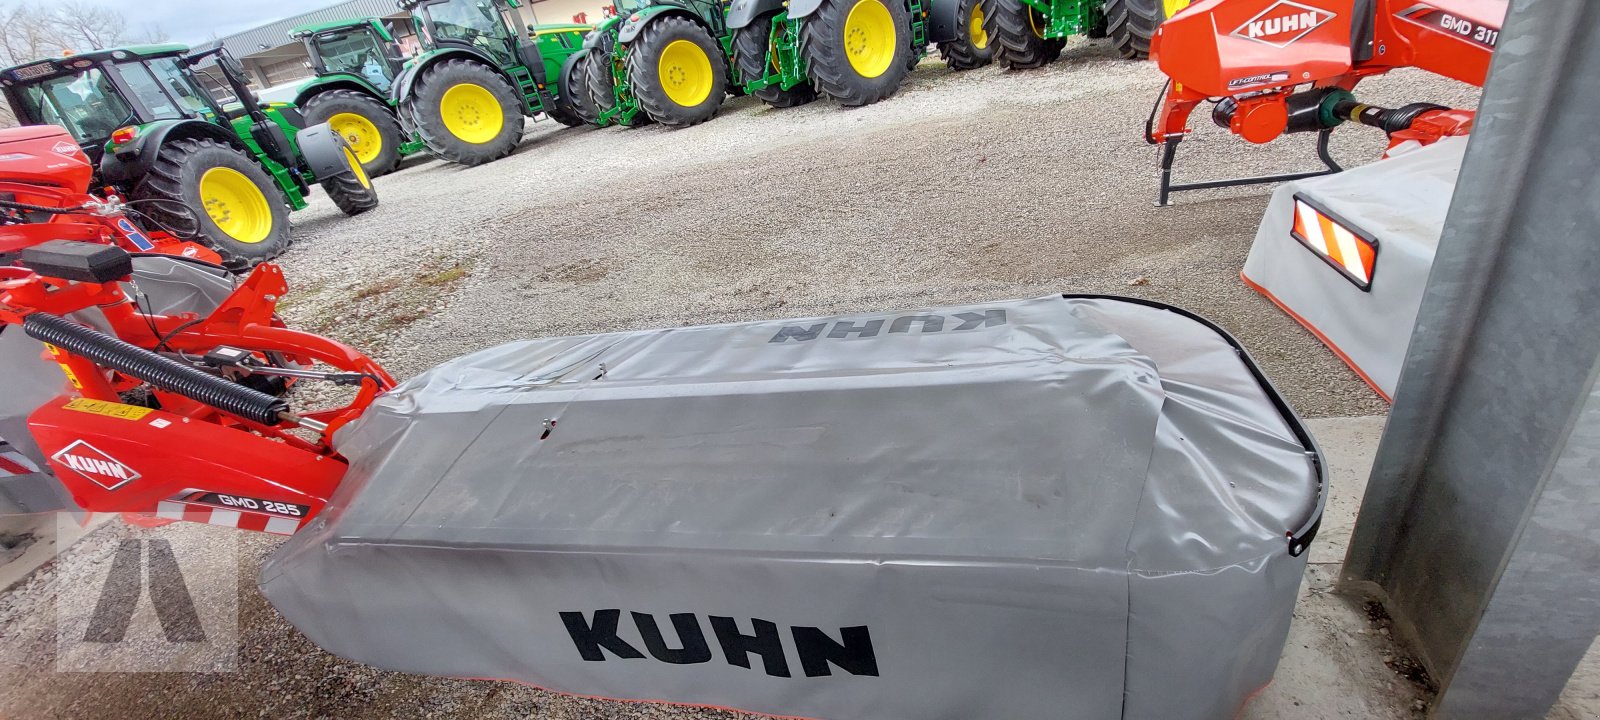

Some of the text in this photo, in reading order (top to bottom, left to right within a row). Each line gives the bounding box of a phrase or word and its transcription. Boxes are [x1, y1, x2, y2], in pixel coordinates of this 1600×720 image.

[1249, 11, 1318, 38] KUHN
[1440, 13, 1499, 46] GMD 311
[768, 309, 1007, 344] KUHN
[63, 453, 128, 480] KUHN
[217, 494, 301, 516] GMD 285
[558, 608, 879, 678] KUHN
